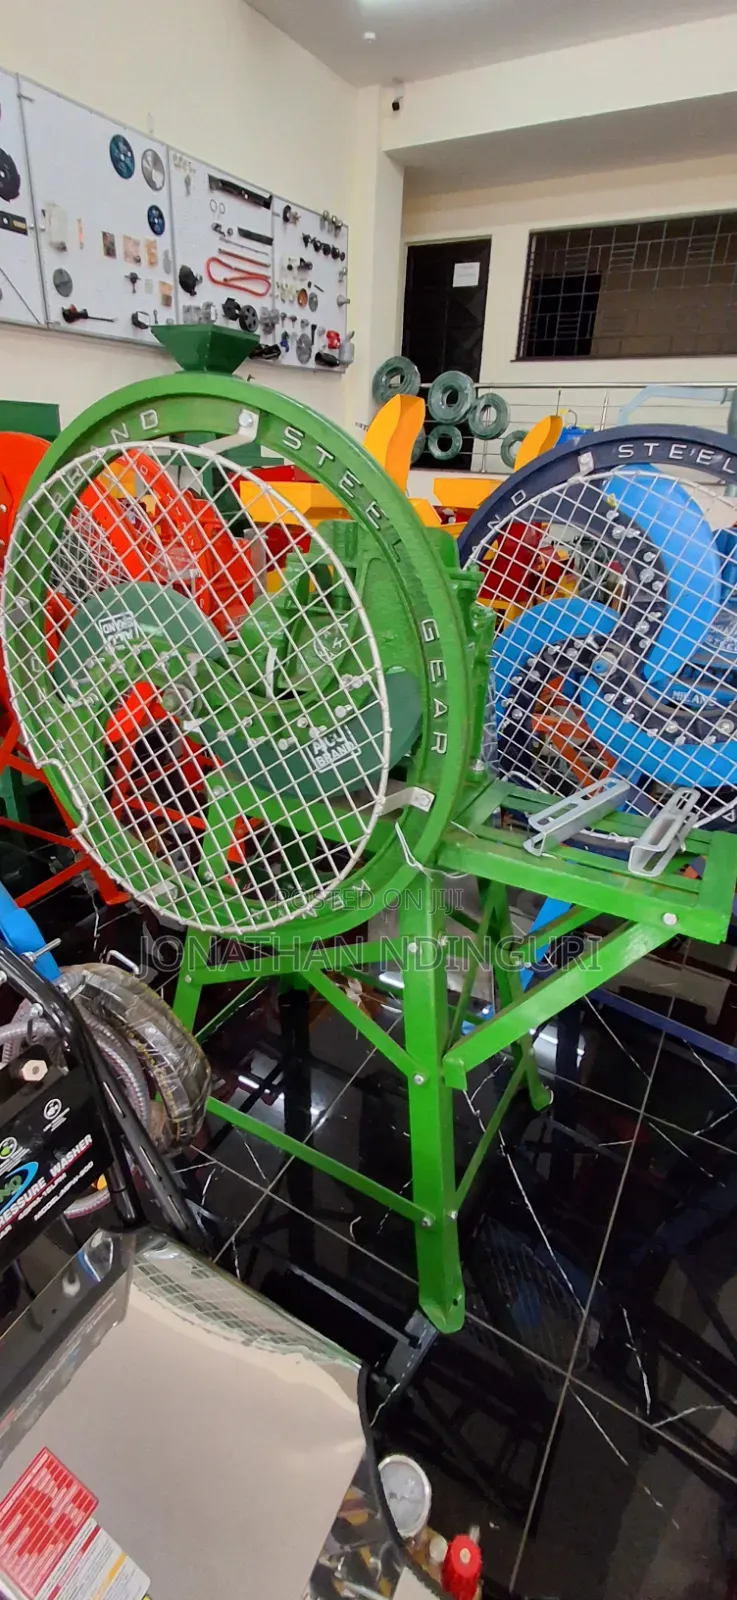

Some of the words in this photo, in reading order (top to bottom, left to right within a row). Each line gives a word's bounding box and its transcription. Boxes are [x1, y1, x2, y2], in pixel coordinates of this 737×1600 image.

[618, 442, 736, 475] STEEL
[282, 426, 402, 562] STEEL
[420, 618, 448, 756] GEAR
[315, 740, 356, 767] BRAND
[50, 1133, 93, 1178] WASHER
